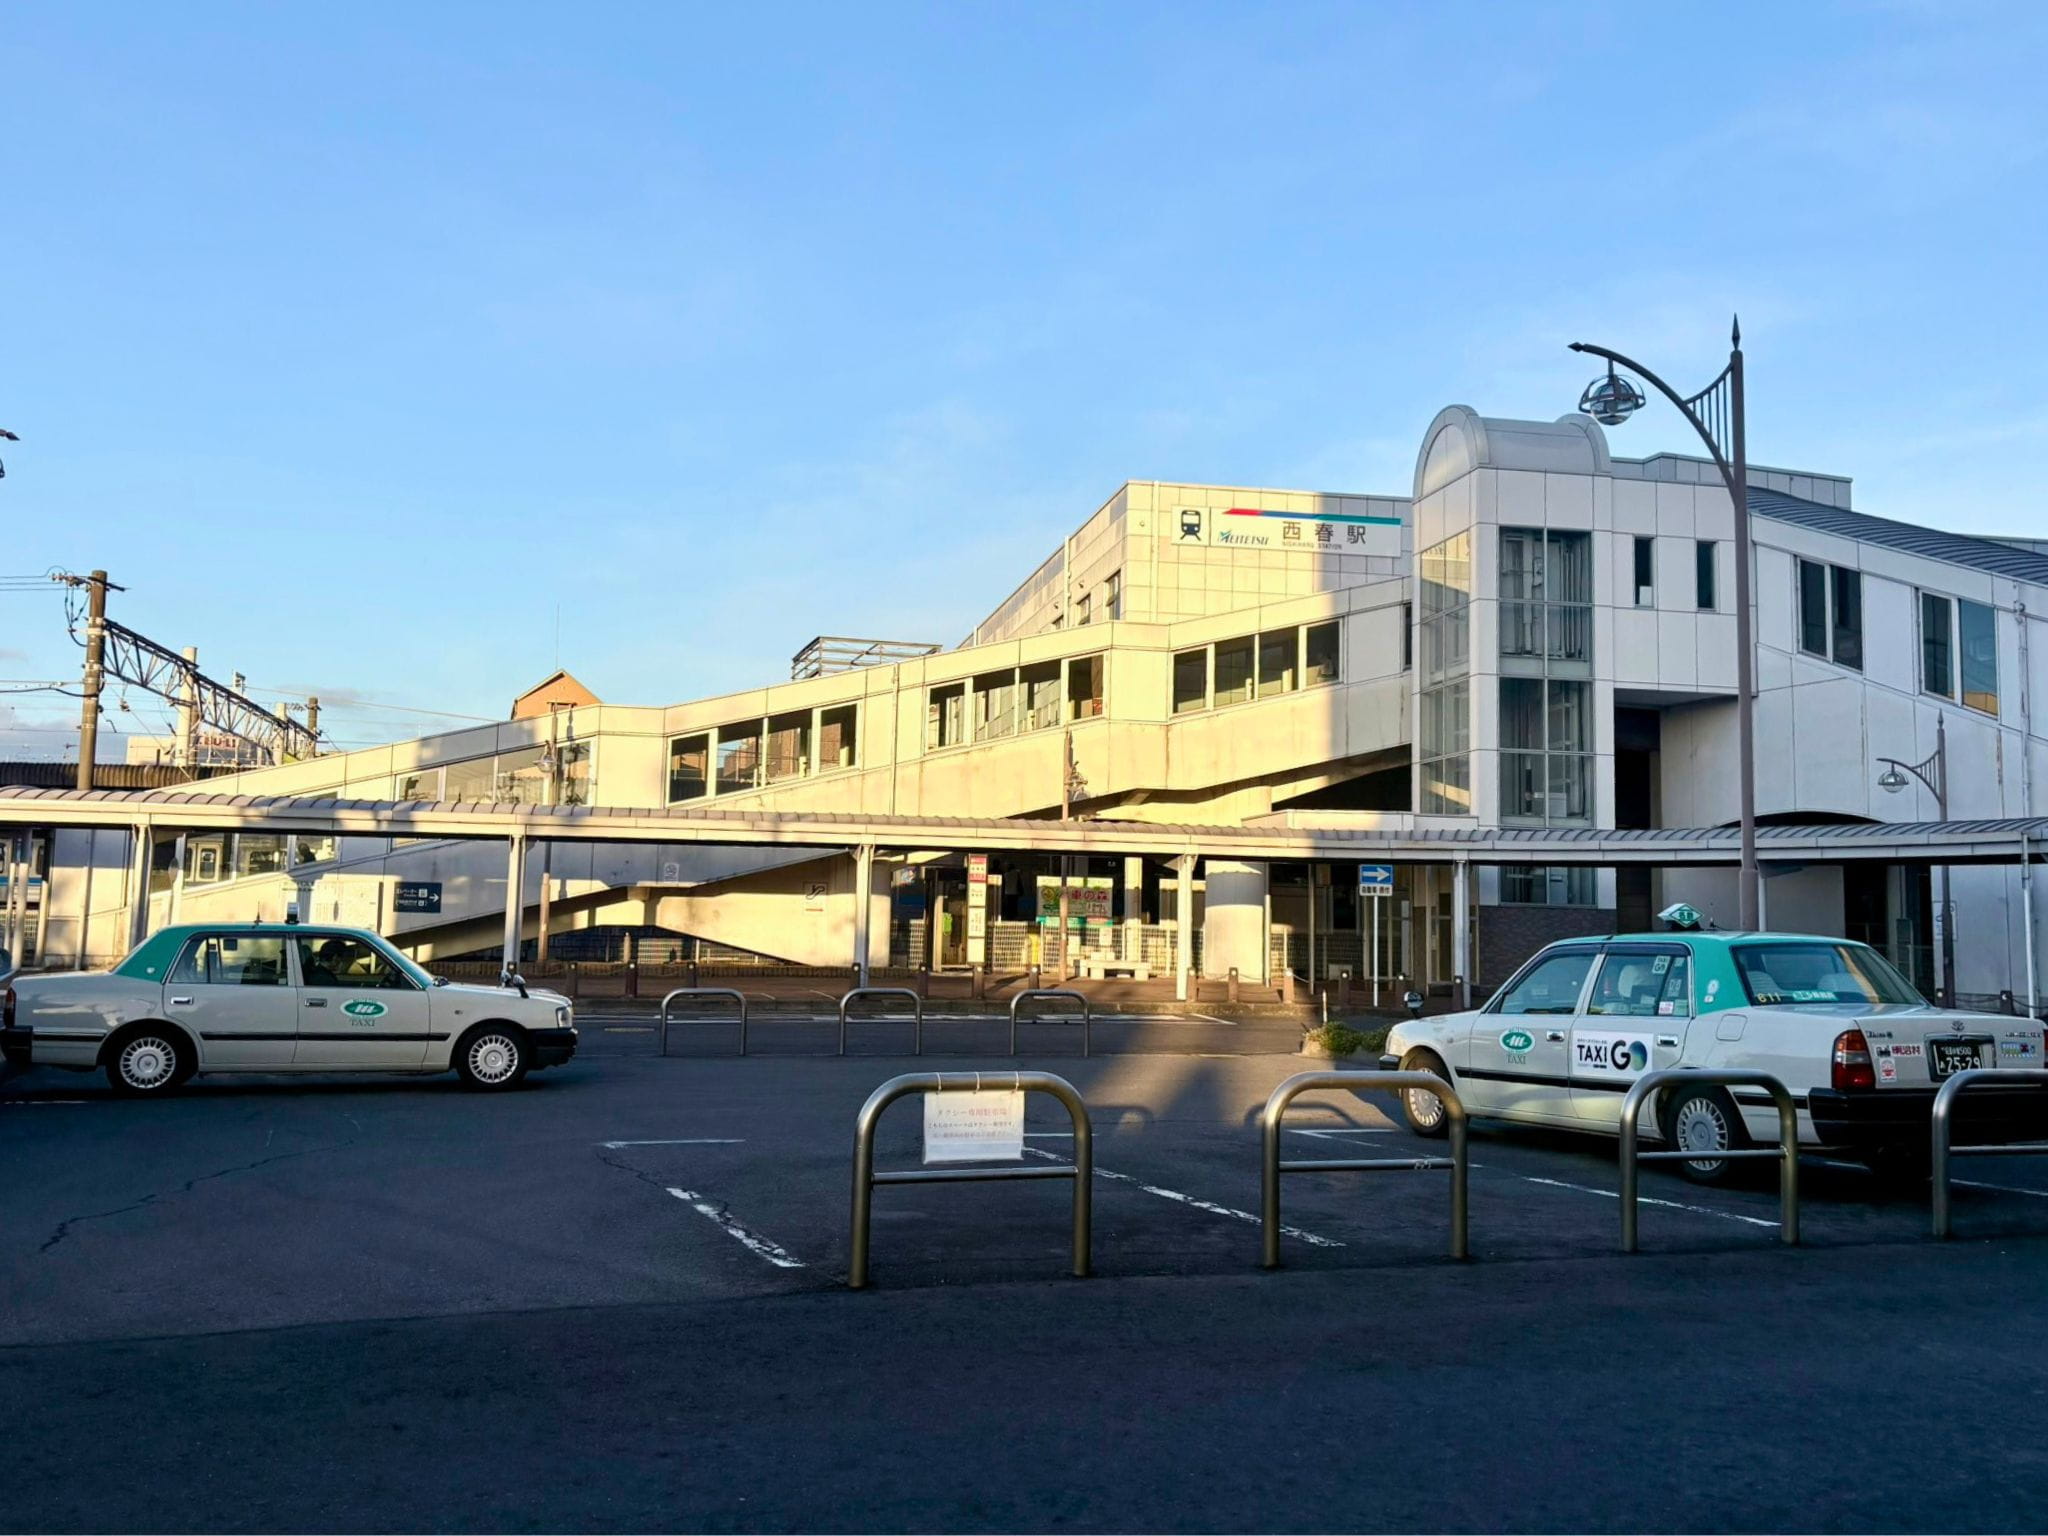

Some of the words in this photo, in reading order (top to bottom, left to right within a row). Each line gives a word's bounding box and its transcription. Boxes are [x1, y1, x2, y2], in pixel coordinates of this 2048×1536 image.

[1218, 530, 1269, 545] MEITETSU
[1283, 521, 1366, 544] 西春駅
[1757, 992, 1782, 1003] 611
[1507, 1053, 1527, 1065] TAXI
[1577, 1044, 1608, 1063] TAXI
